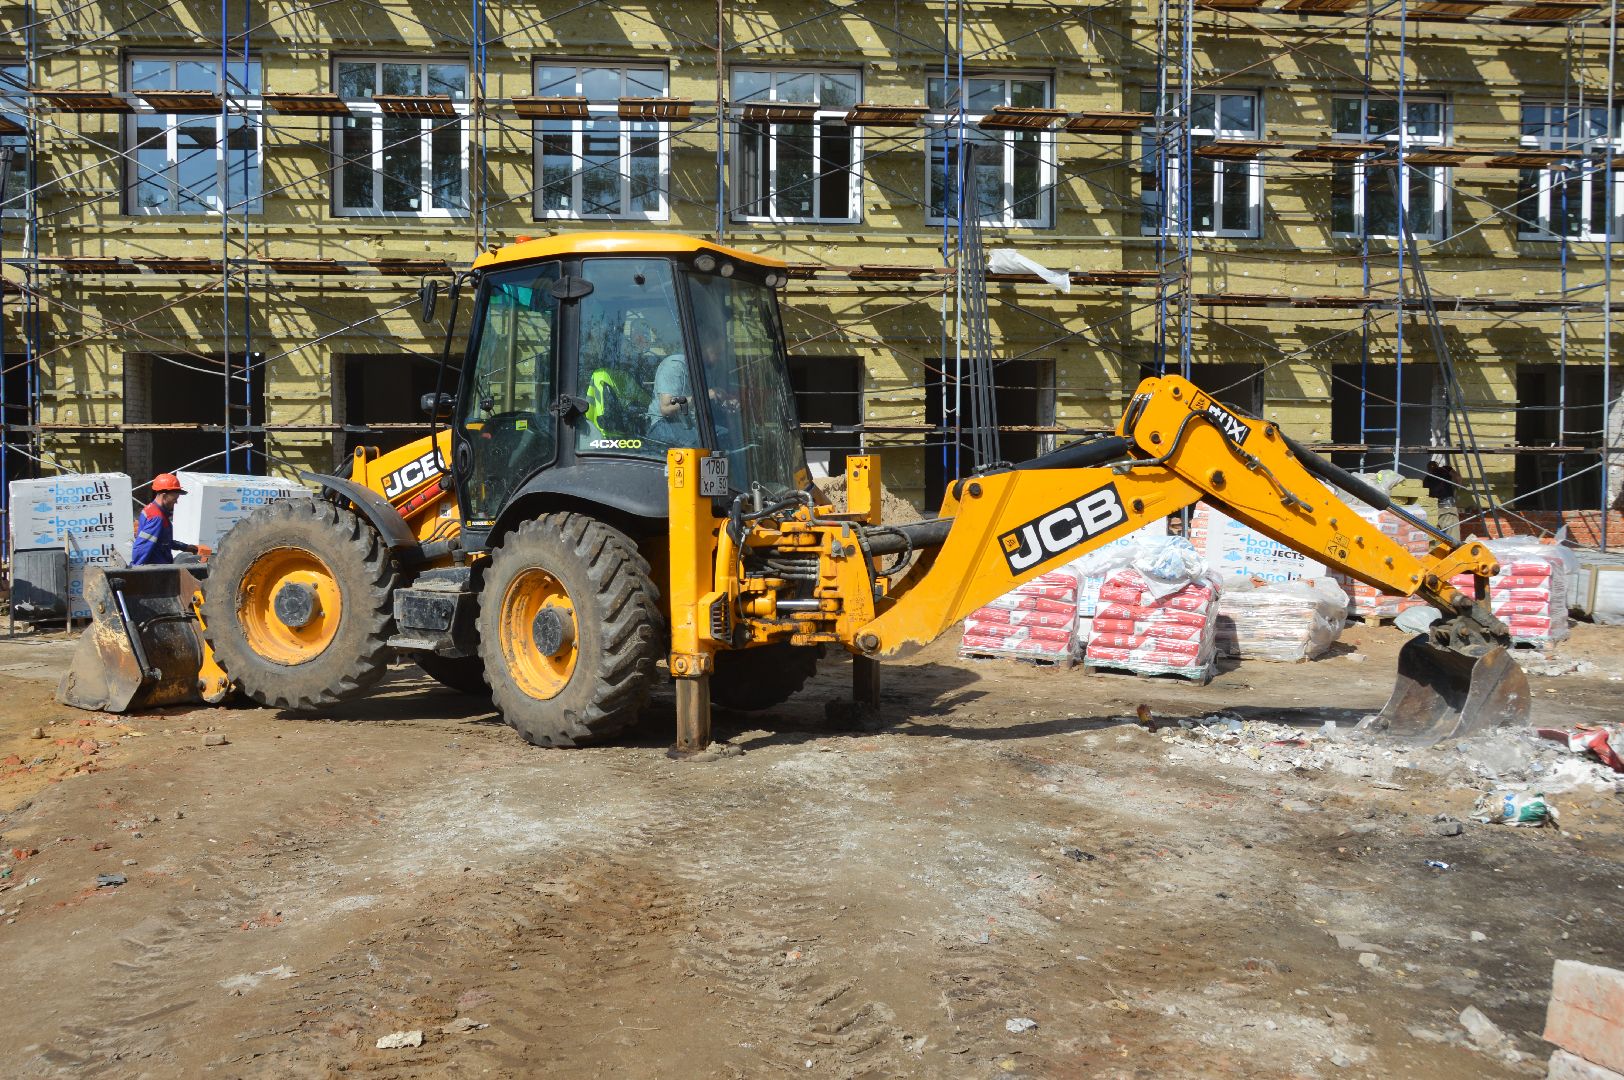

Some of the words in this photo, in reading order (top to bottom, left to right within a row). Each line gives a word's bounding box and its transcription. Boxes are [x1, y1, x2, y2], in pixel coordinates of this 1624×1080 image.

[386, 450, 445, 498] JCB
[706, 460, 725, 475] 1780
[56, 480, 109, 495] bonolit
[243, 488, 290, 497] bonolit
[56, 493, 111, 504] PROJECTS
[56, 512, 114, 527] bonolit
[1010, 489, 1123, 569] JCB
[70, 544, 114, 557] onolit
[1246, 547, 1305, 560] PROJECTS
